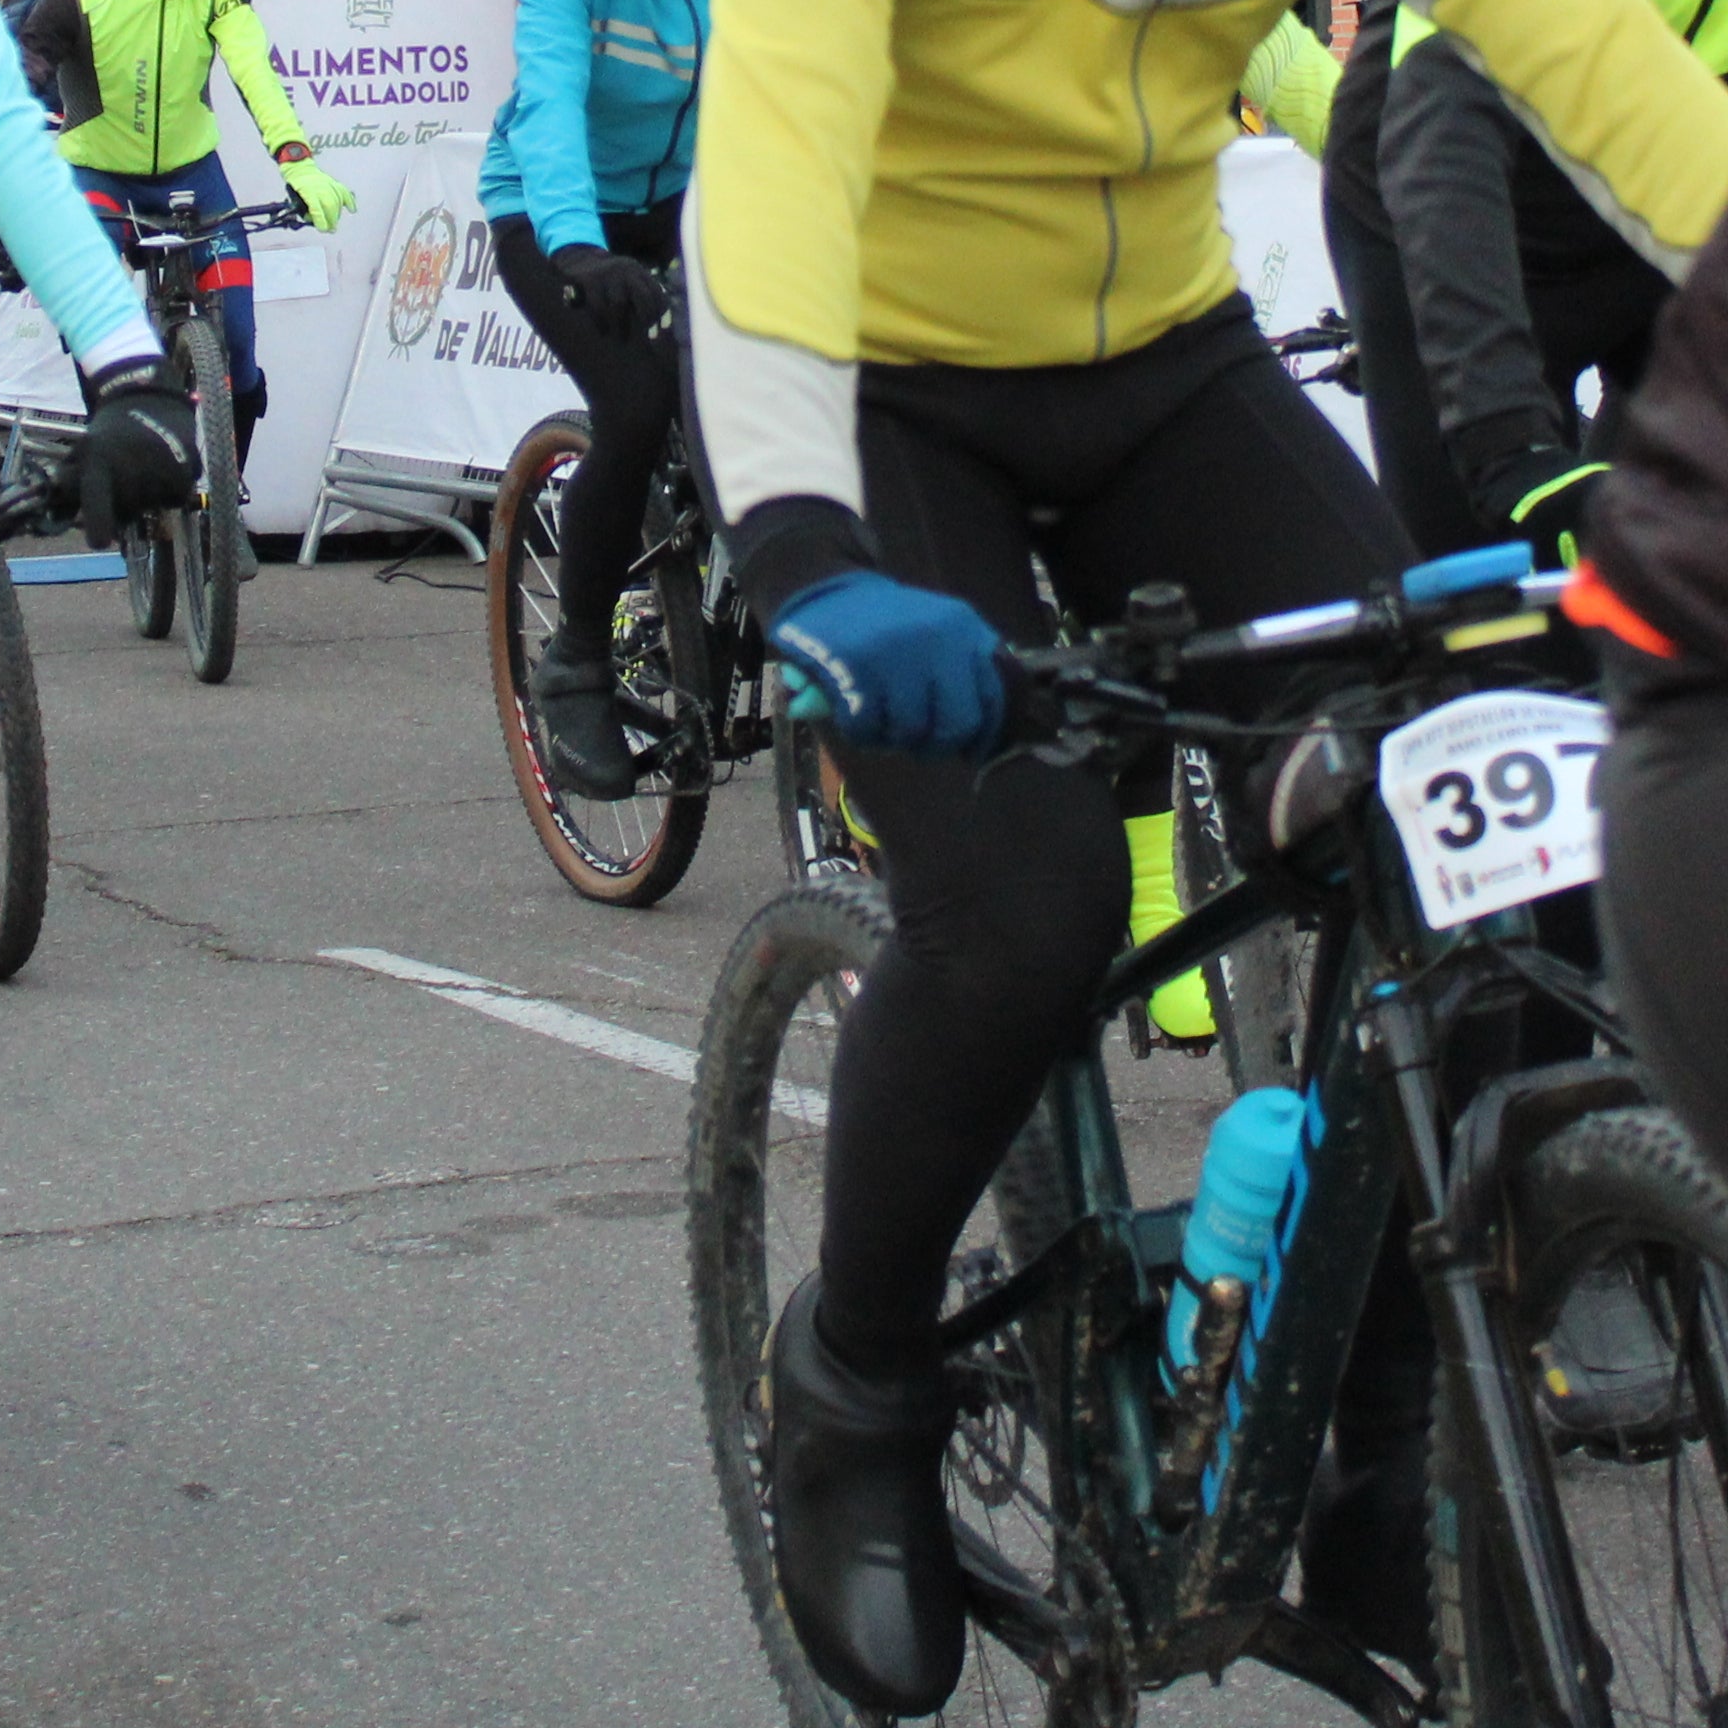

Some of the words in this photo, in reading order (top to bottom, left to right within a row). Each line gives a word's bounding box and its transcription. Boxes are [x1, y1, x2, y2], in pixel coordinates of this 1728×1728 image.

[308, 80, 470, 108] VALLADOLID
[380, 122, 409, 147] de
[434, 318, 470, 363] DE
